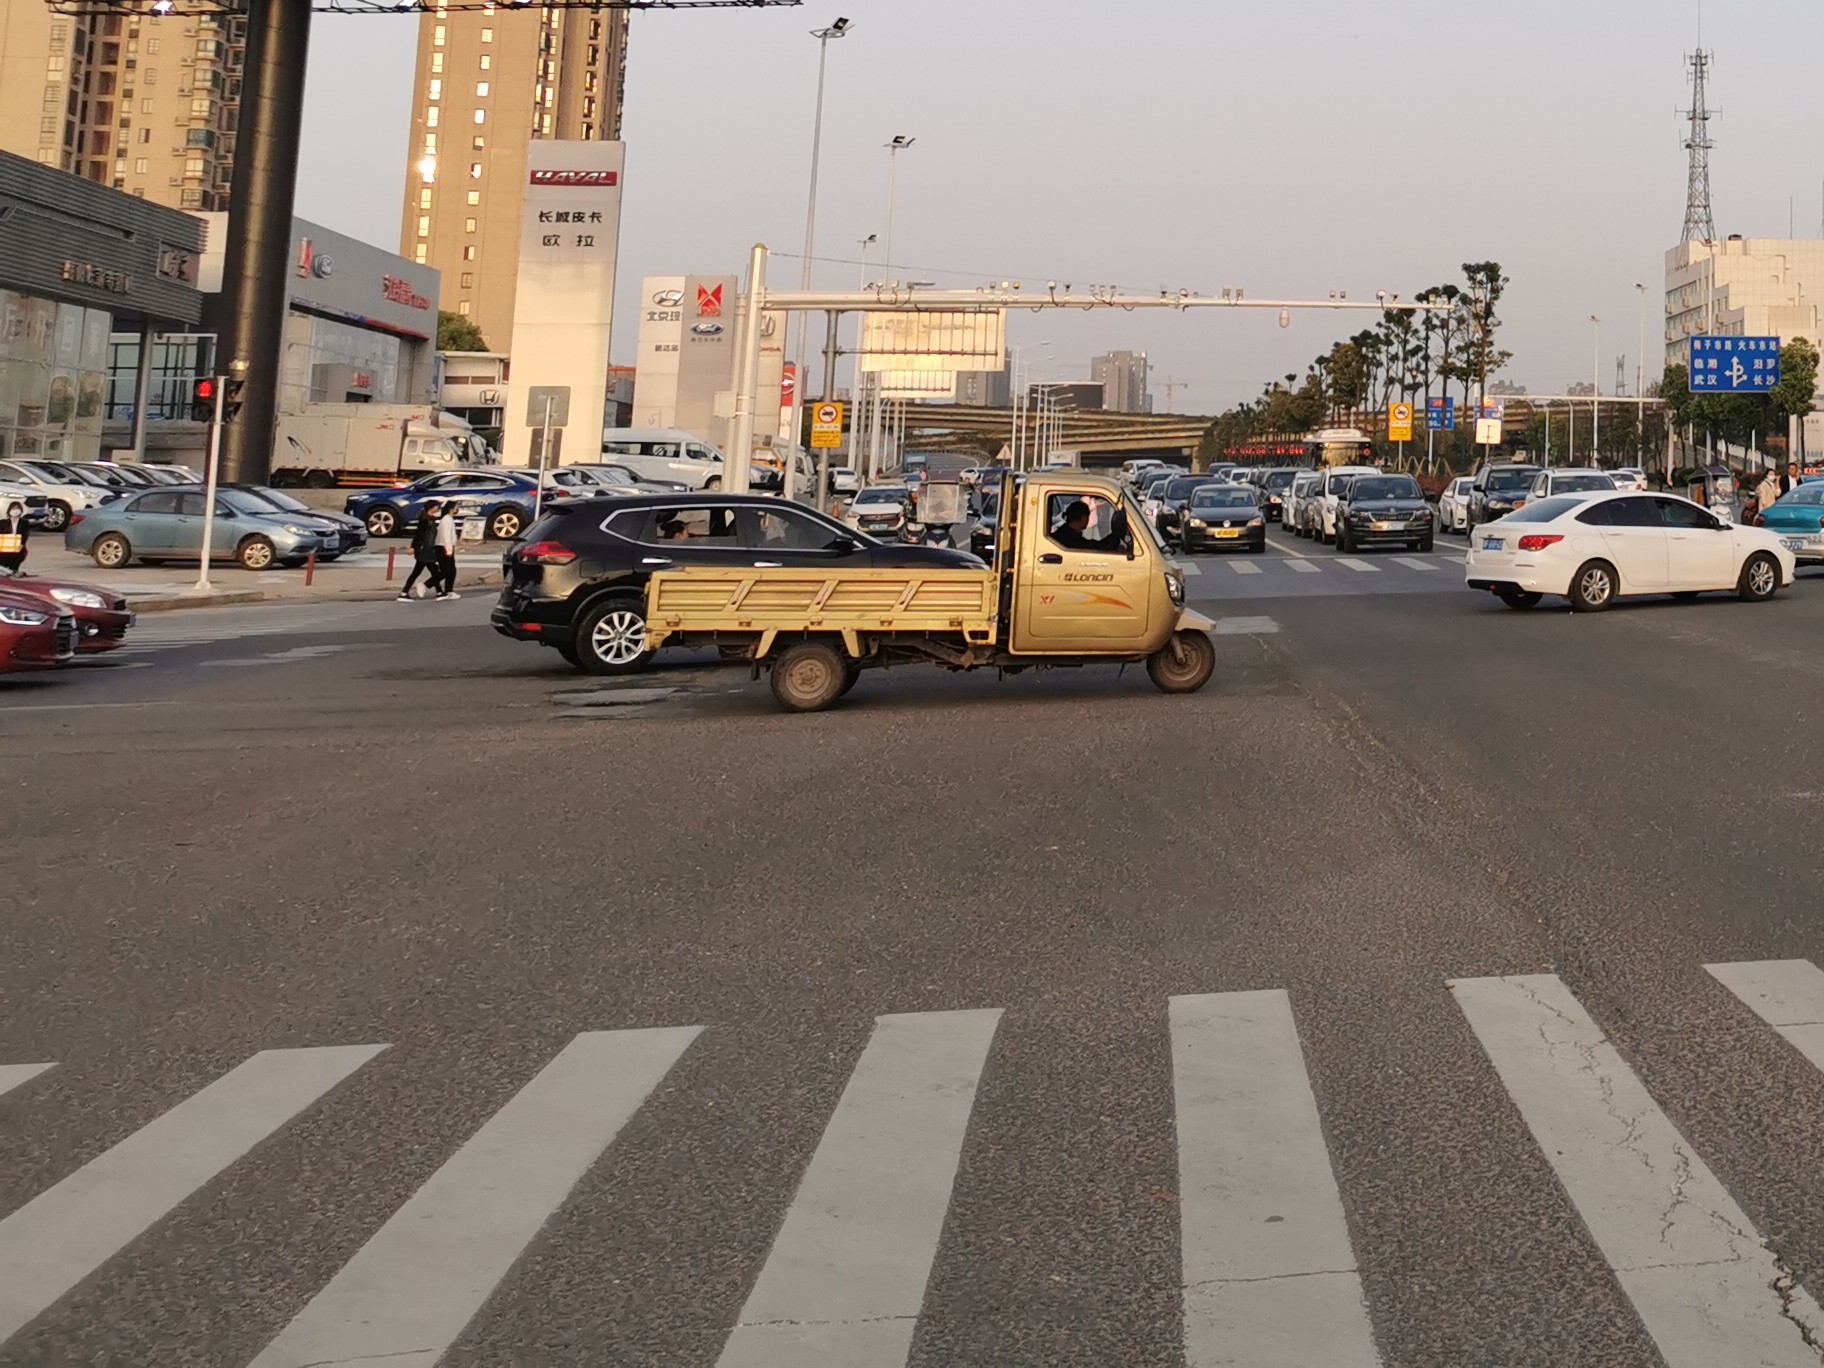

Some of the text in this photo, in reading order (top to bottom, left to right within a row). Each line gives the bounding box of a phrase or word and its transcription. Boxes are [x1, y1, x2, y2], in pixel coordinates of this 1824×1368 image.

[535, 171, 613, 183] HAVAL
[538, 210, 603, 224] 长城皮卡
